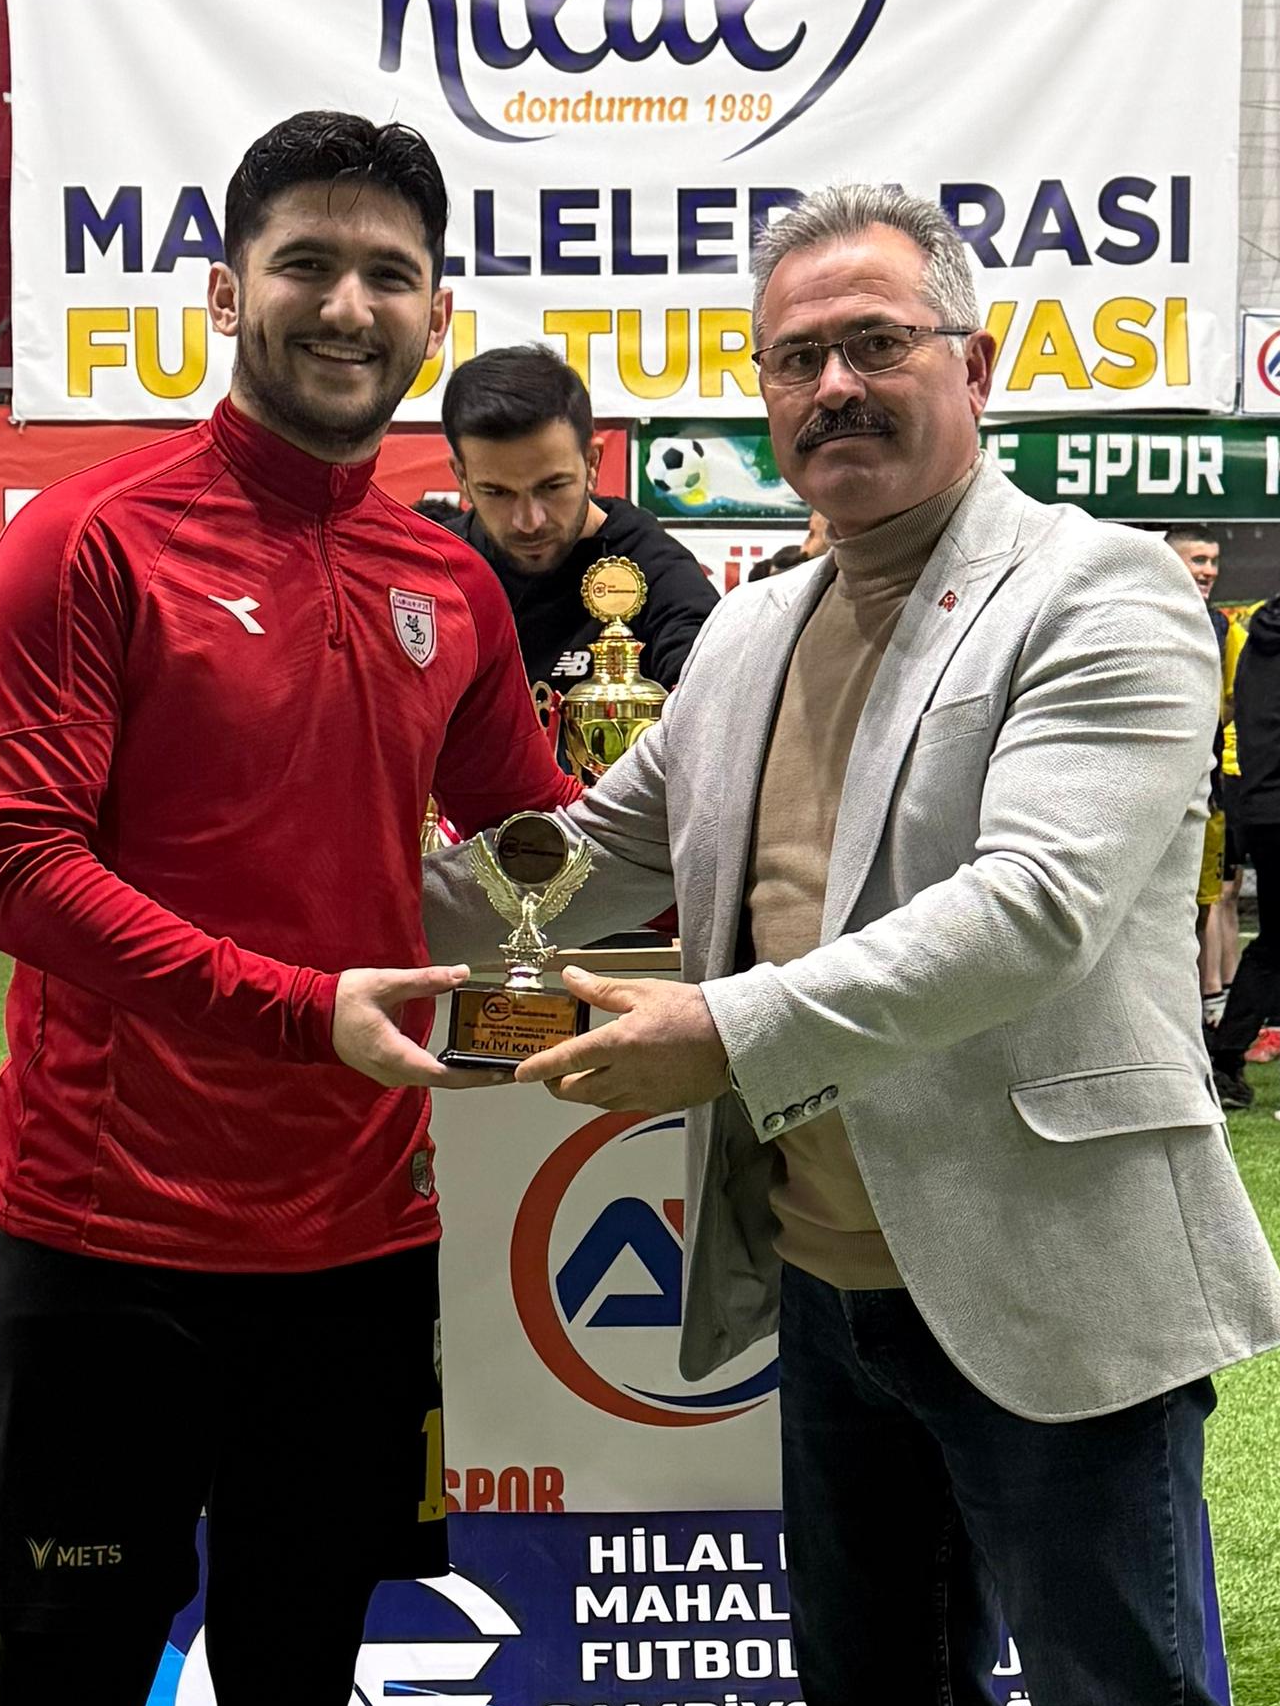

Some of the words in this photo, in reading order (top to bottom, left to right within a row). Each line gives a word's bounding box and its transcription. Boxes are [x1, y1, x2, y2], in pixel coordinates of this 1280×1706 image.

[503, 89, 688, 124] dondurma
[704, 92, 773, 123] 1989
[1056, 433, 1225, 495] SPOR
[56, 1545, 123, 1567] METS
[588, 1526, 764, 1576] HİLAL
